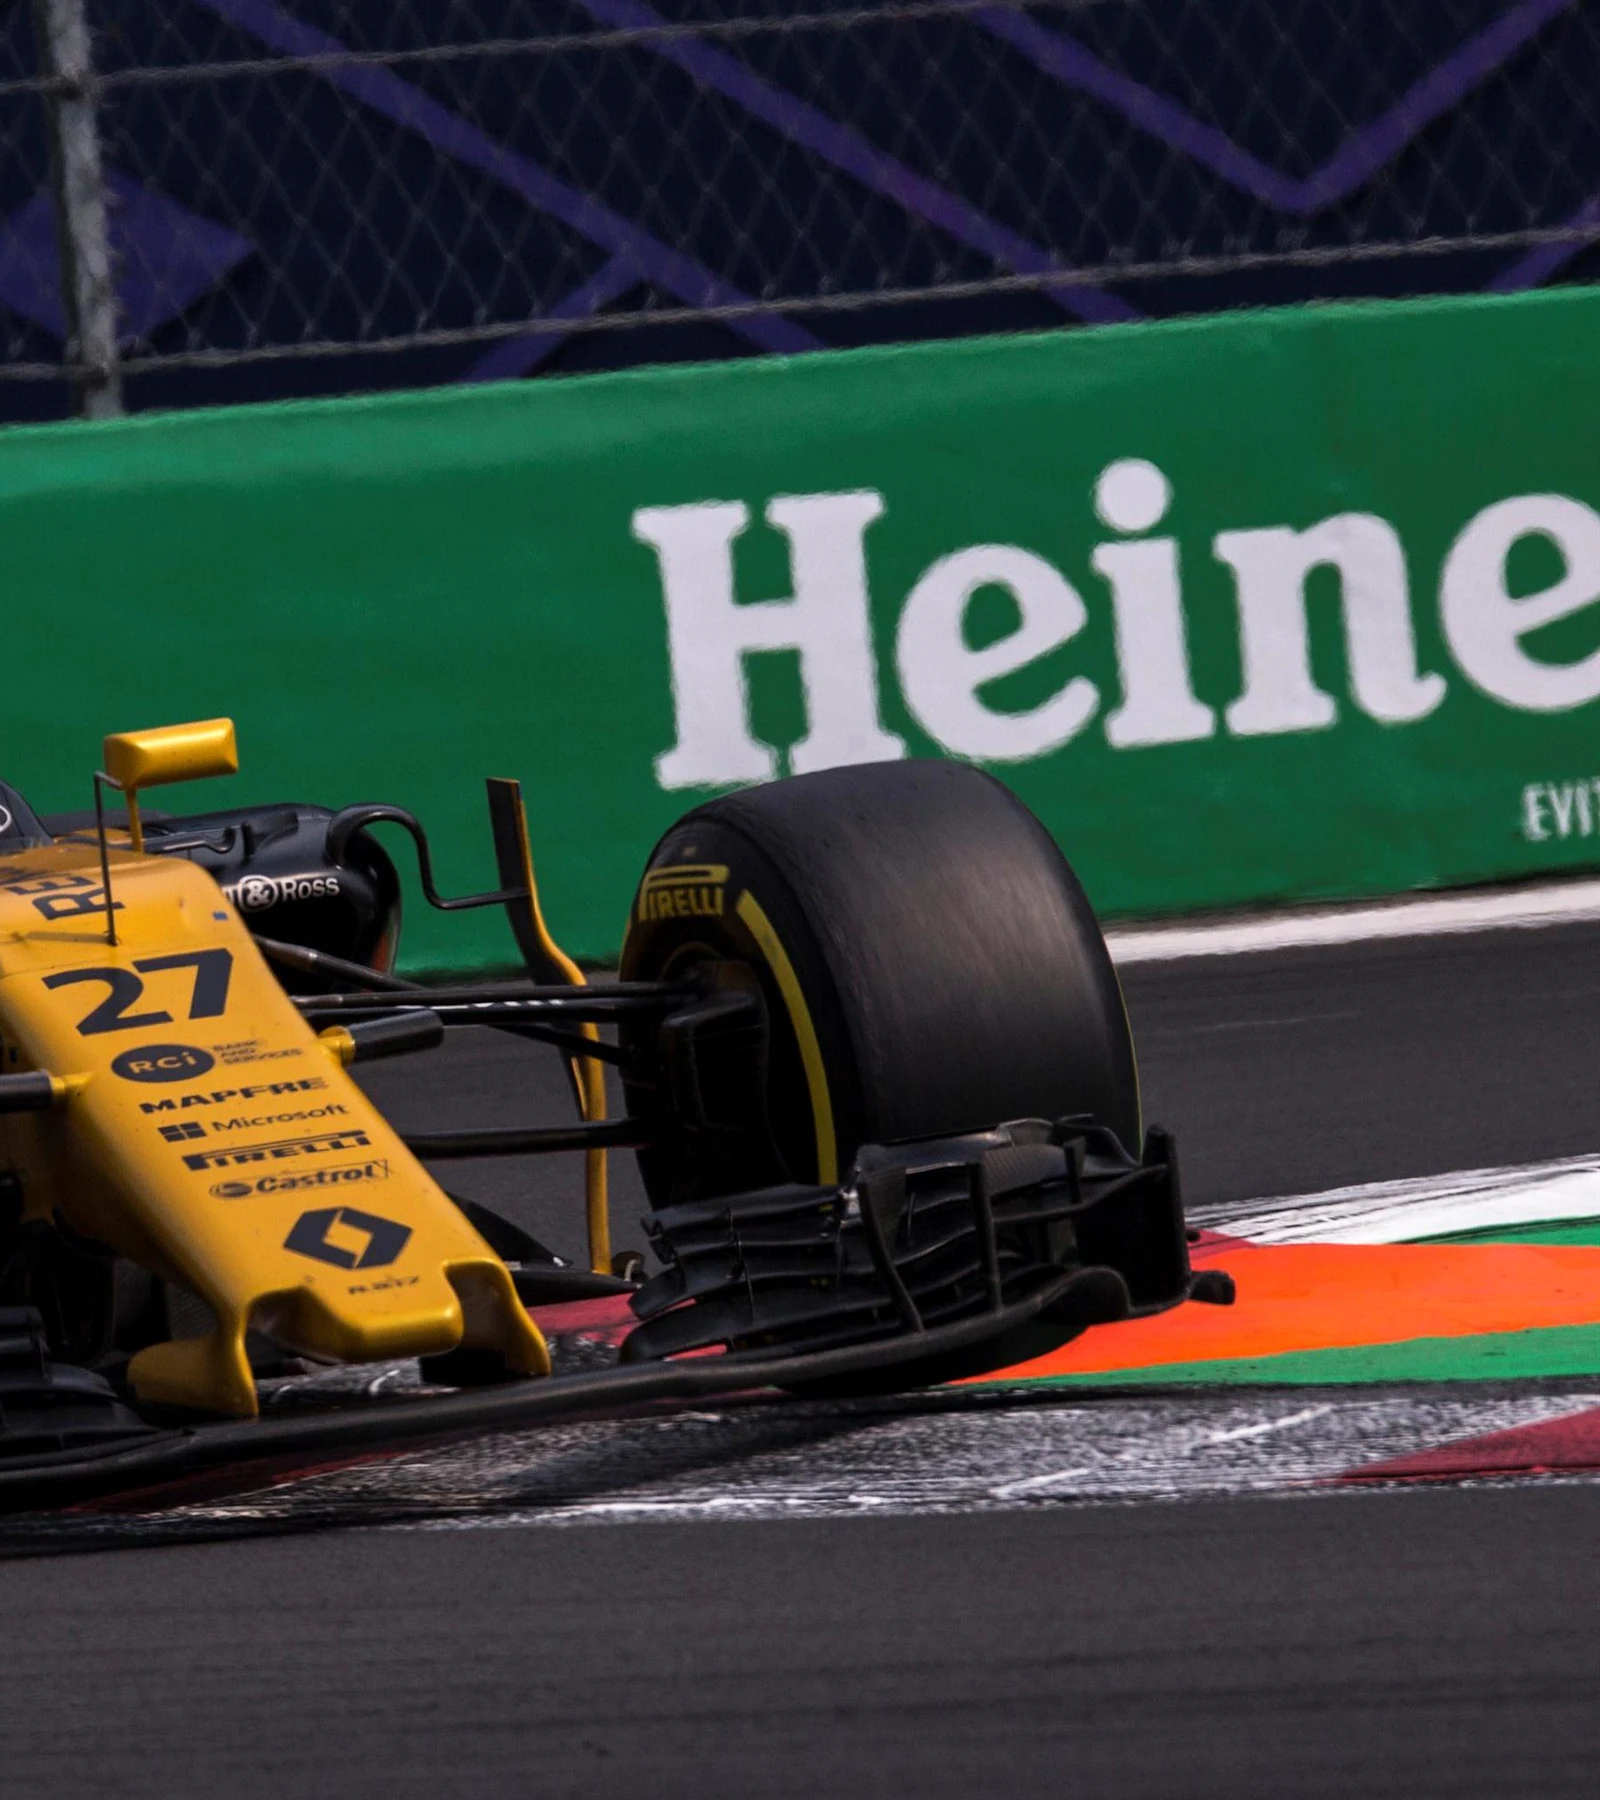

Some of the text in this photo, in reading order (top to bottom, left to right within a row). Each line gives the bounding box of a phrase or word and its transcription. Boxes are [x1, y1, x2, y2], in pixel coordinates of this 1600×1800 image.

[630, 456, 1600, 791] Heine
[637, 863, 730, 924] PIRELLI
[41, 947, 233, 1036] 27
[139, 1076, 329, 1115] MAPFRE
[211, 1103, 349, 1132] Microsoft
[182, 1130, 371, 1171] PIRELLI
[256, 1163, 375, 1192] Castrol
